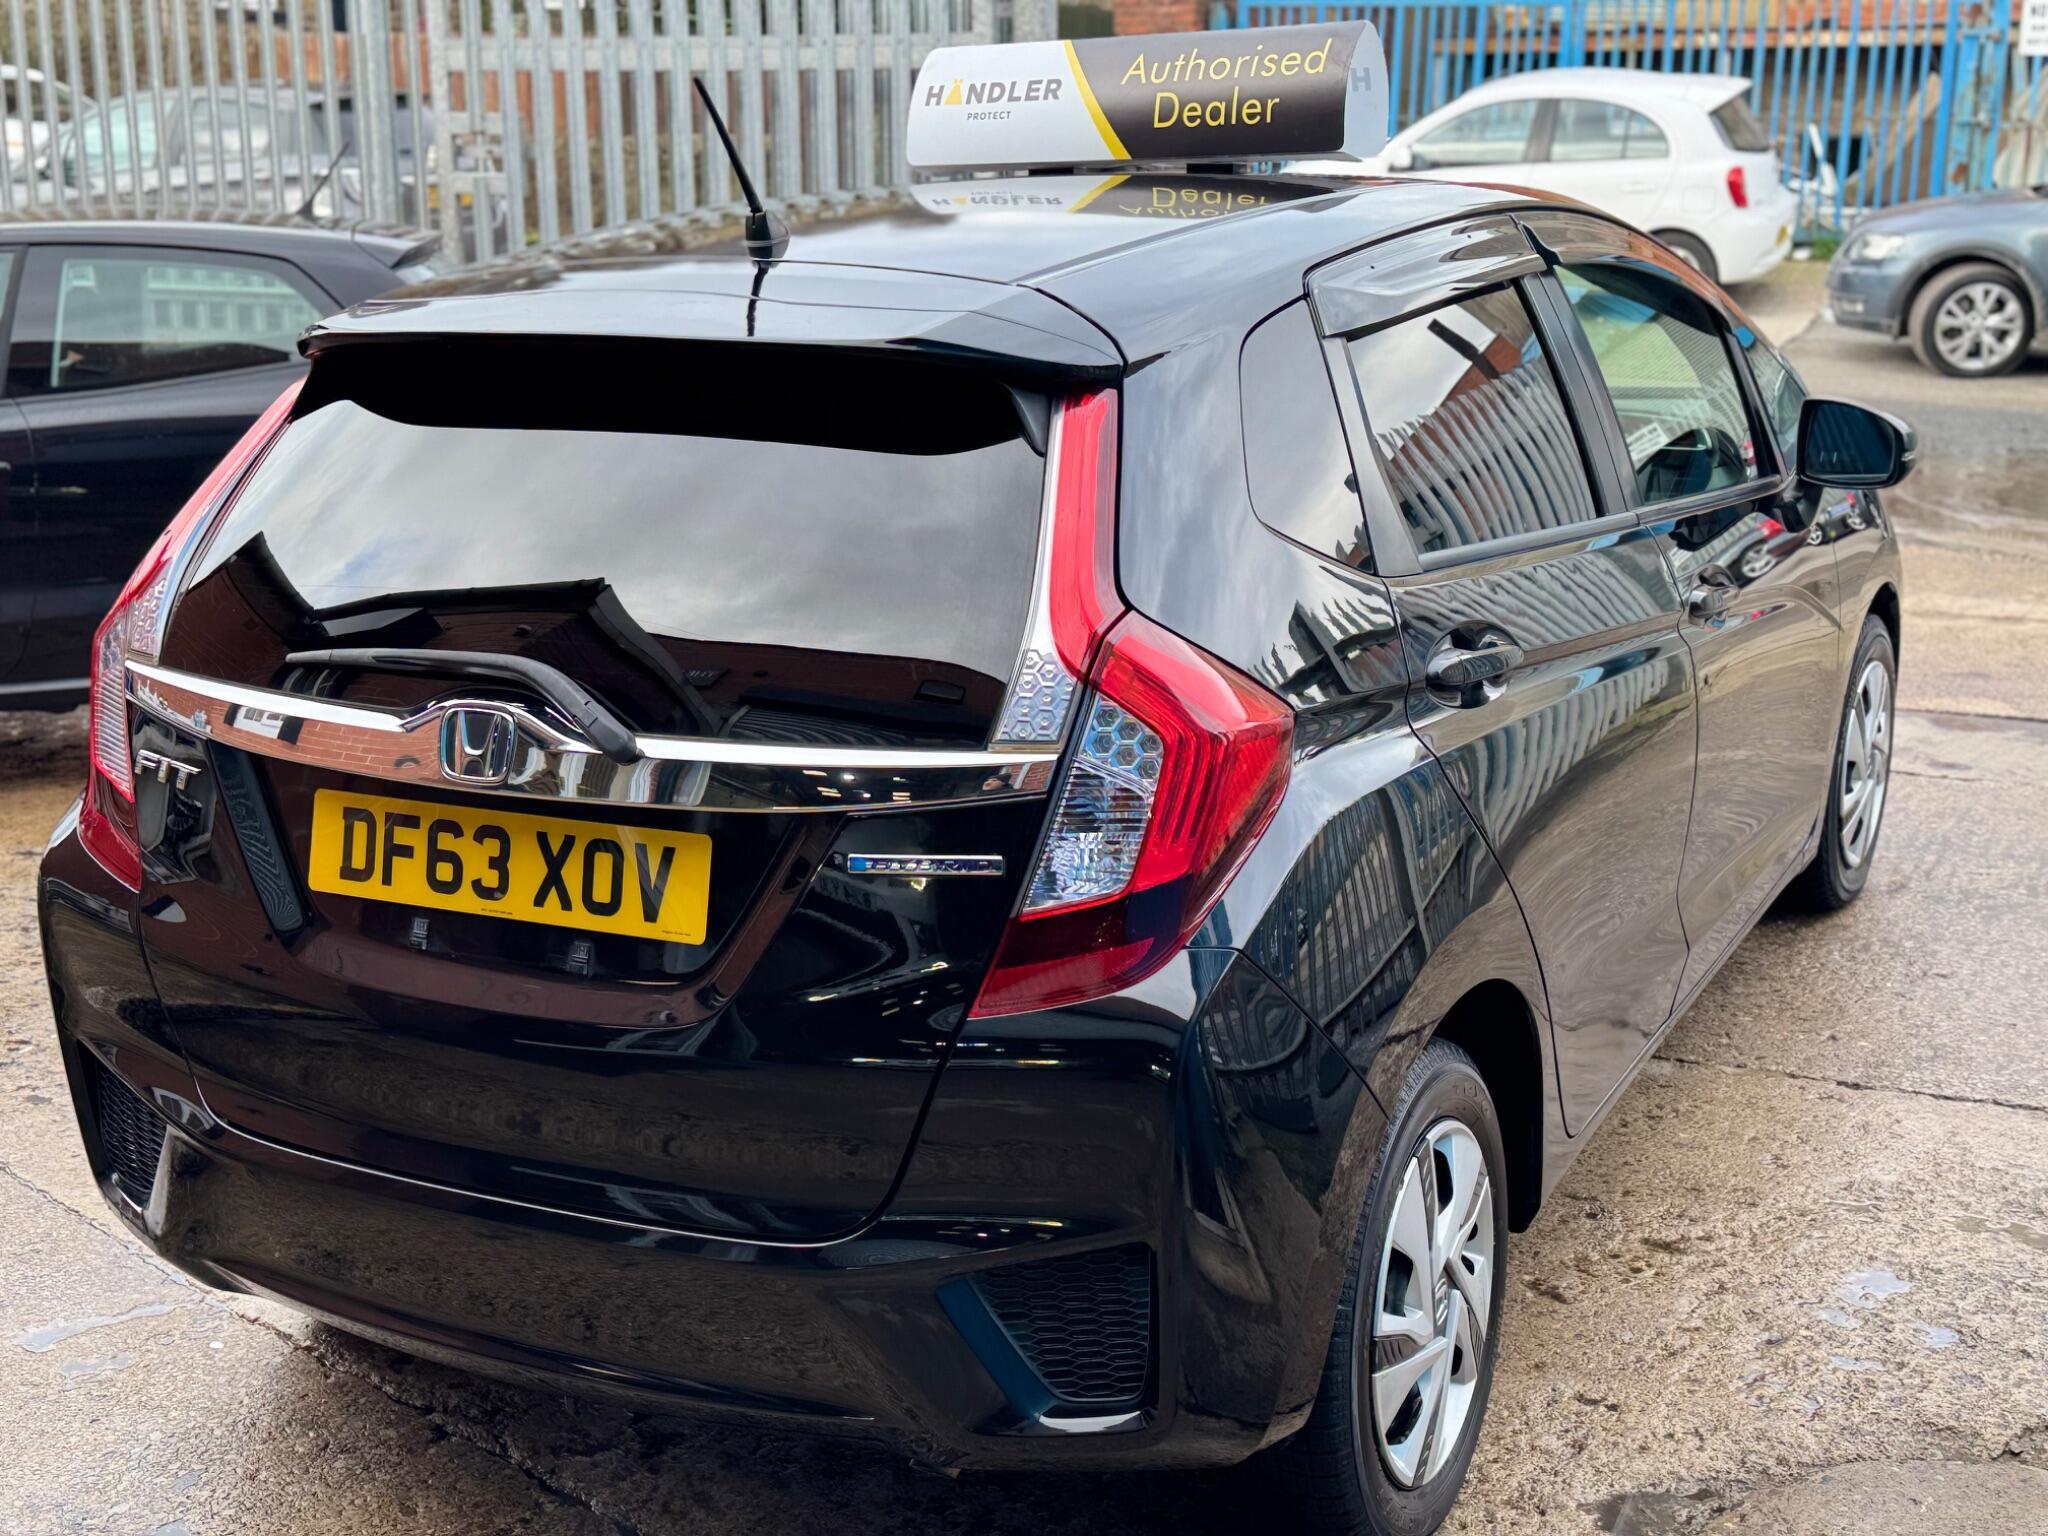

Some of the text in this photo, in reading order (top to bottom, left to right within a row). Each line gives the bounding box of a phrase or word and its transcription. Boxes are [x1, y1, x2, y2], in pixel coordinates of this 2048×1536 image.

[1120, 38, 1333, 85] Authorised
[966, 111, 1012, 121] PROTECT
[1153, 86, 1280, 129] Dealer
[339, 806, 677, 924] DF63 XOV
